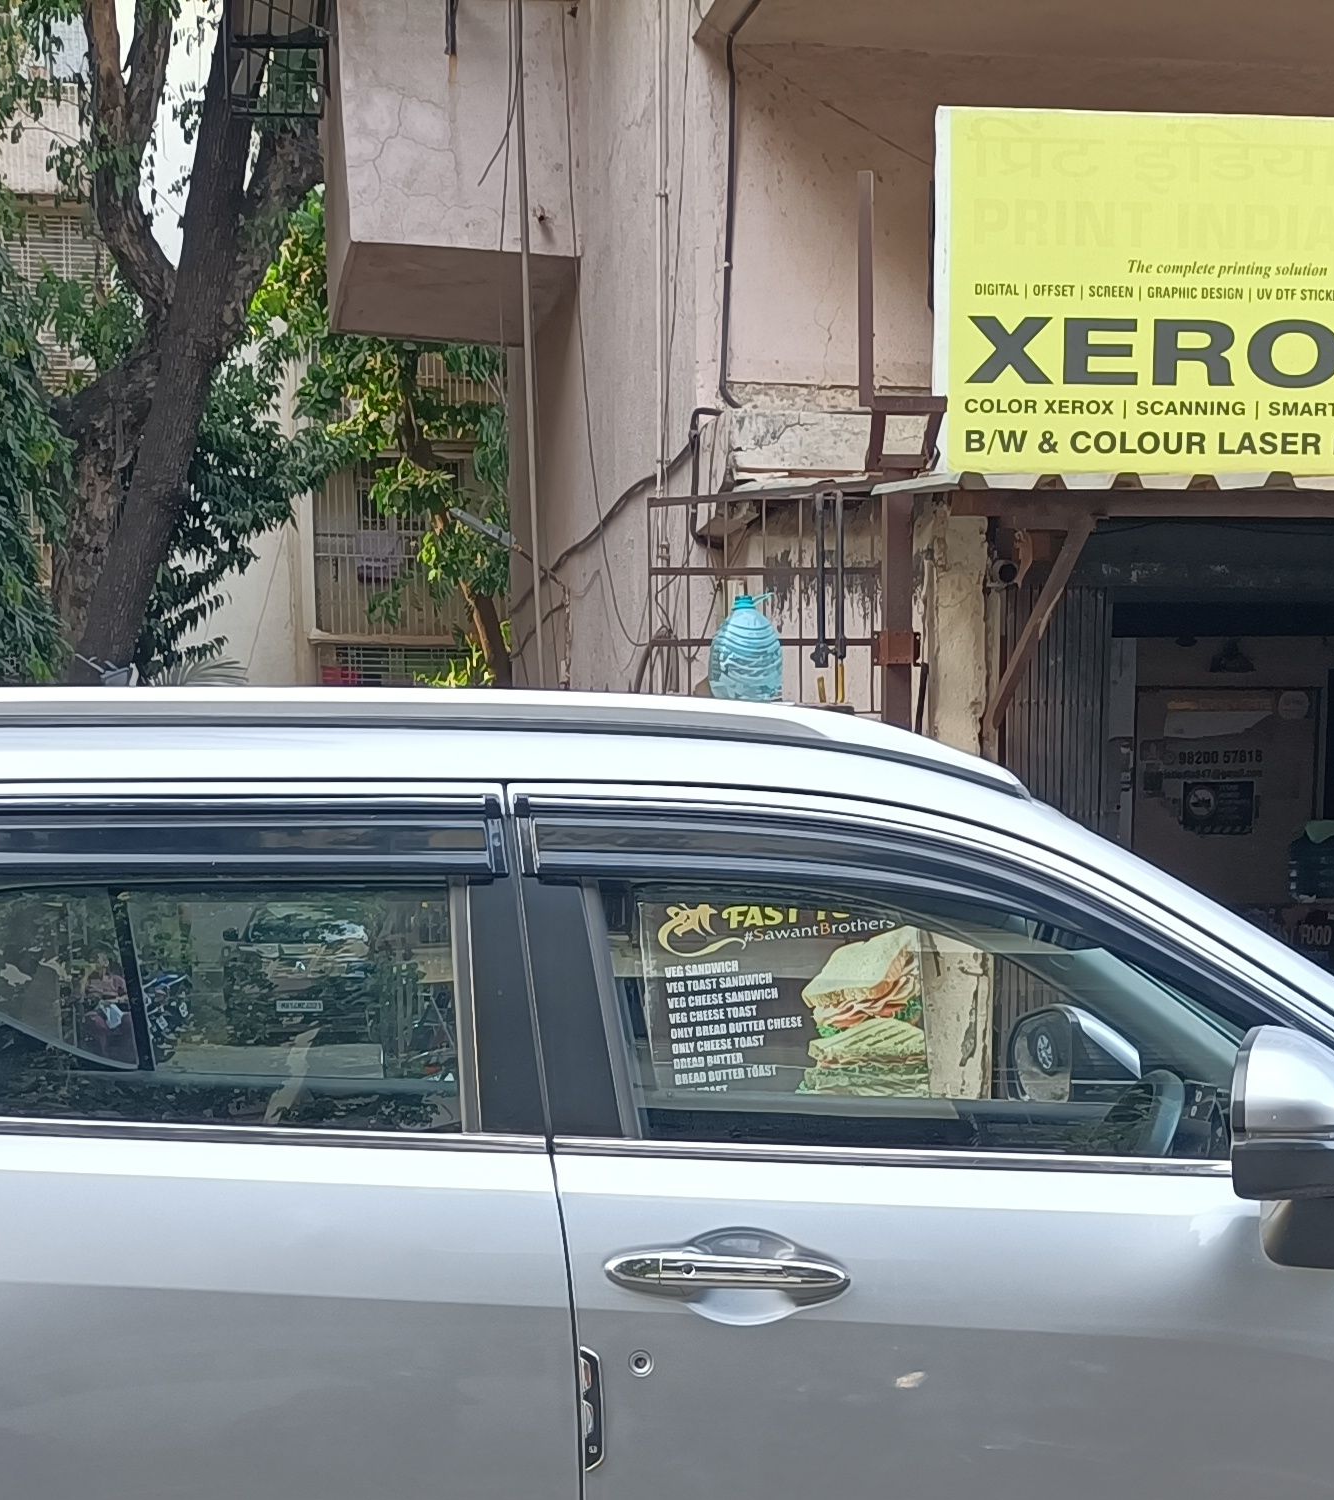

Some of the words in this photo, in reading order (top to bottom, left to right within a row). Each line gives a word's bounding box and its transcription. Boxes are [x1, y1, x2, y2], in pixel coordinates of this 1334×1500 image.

[973, 199, 1152, 249] PRINT
[1127, 259, 1151, 275] The
[1156, 260, 1215, 278] complete
[1217, 261, 1271, 279] printing
[1275, 262, 1328, 277] solution
[974, 283, 1019, 297] DIGITAL
[1033, 284, 1075, 298] OFFSET
[1089, 285, 1133, 299] SCREEN
[1147, 286, 1197, 300] GRAPHIC
[1201, 287, 1243, 300] DESIGN
[1256, 287, 1273, 301] UV
[1276, 288, 1297, 301] DTF
[964, 398, 1037, 415] COLOR
[1044, 399, 1114, 415] XEROX
[1136, 400, 1246, 417] SCANNING
[965, 429, 1028, 456] B/W
[1038, 431, 1059, 455] &
[1070, 431, 1206, 456] COLOUR
[1218, 432, 1321, 456] LASER
[744, 919, 895, 941] #SawantBrothers
[665, 966, 684, 978] VEG
[685, 960, 739, 976] SANDWICH
[666, 981, 685, 993] VEG
[686, 978, 717, 992] TOAST
[719, 972, 773, 988] SANDWICH
[667, 997, 686, 1009] VEG
[688, 993, 723, 1007] CHEESE
[725, 987, 778, 1003] SANDWICH
[669, 1012, 687, 1024] VEG
[689, 1008, 724, 1022] CHEESE
[726, 1005, 757, 1019] TOAST
[671, 1026, 693, 1039] ONLY
[695, 1023, 727, 1037] BREAD
[729, 1020, 765, 1034] BUTTER
[767, 1016, 802, 1030] CHEESE
[672, 1042, 695, 1054] ONLY
[697, 1038, 732, 1052] CHEESE
[733, 1035, 764, 1048] TOAST
[673, 1056, 705, 1069] BREAD
[707, 1053, 743, 1066] BUTTER
[675, 1072, 706, 1085] BREAD
[708, 1068, 745, 1082] BUTTER
[746, 1064, 777, 1077] TOAST
